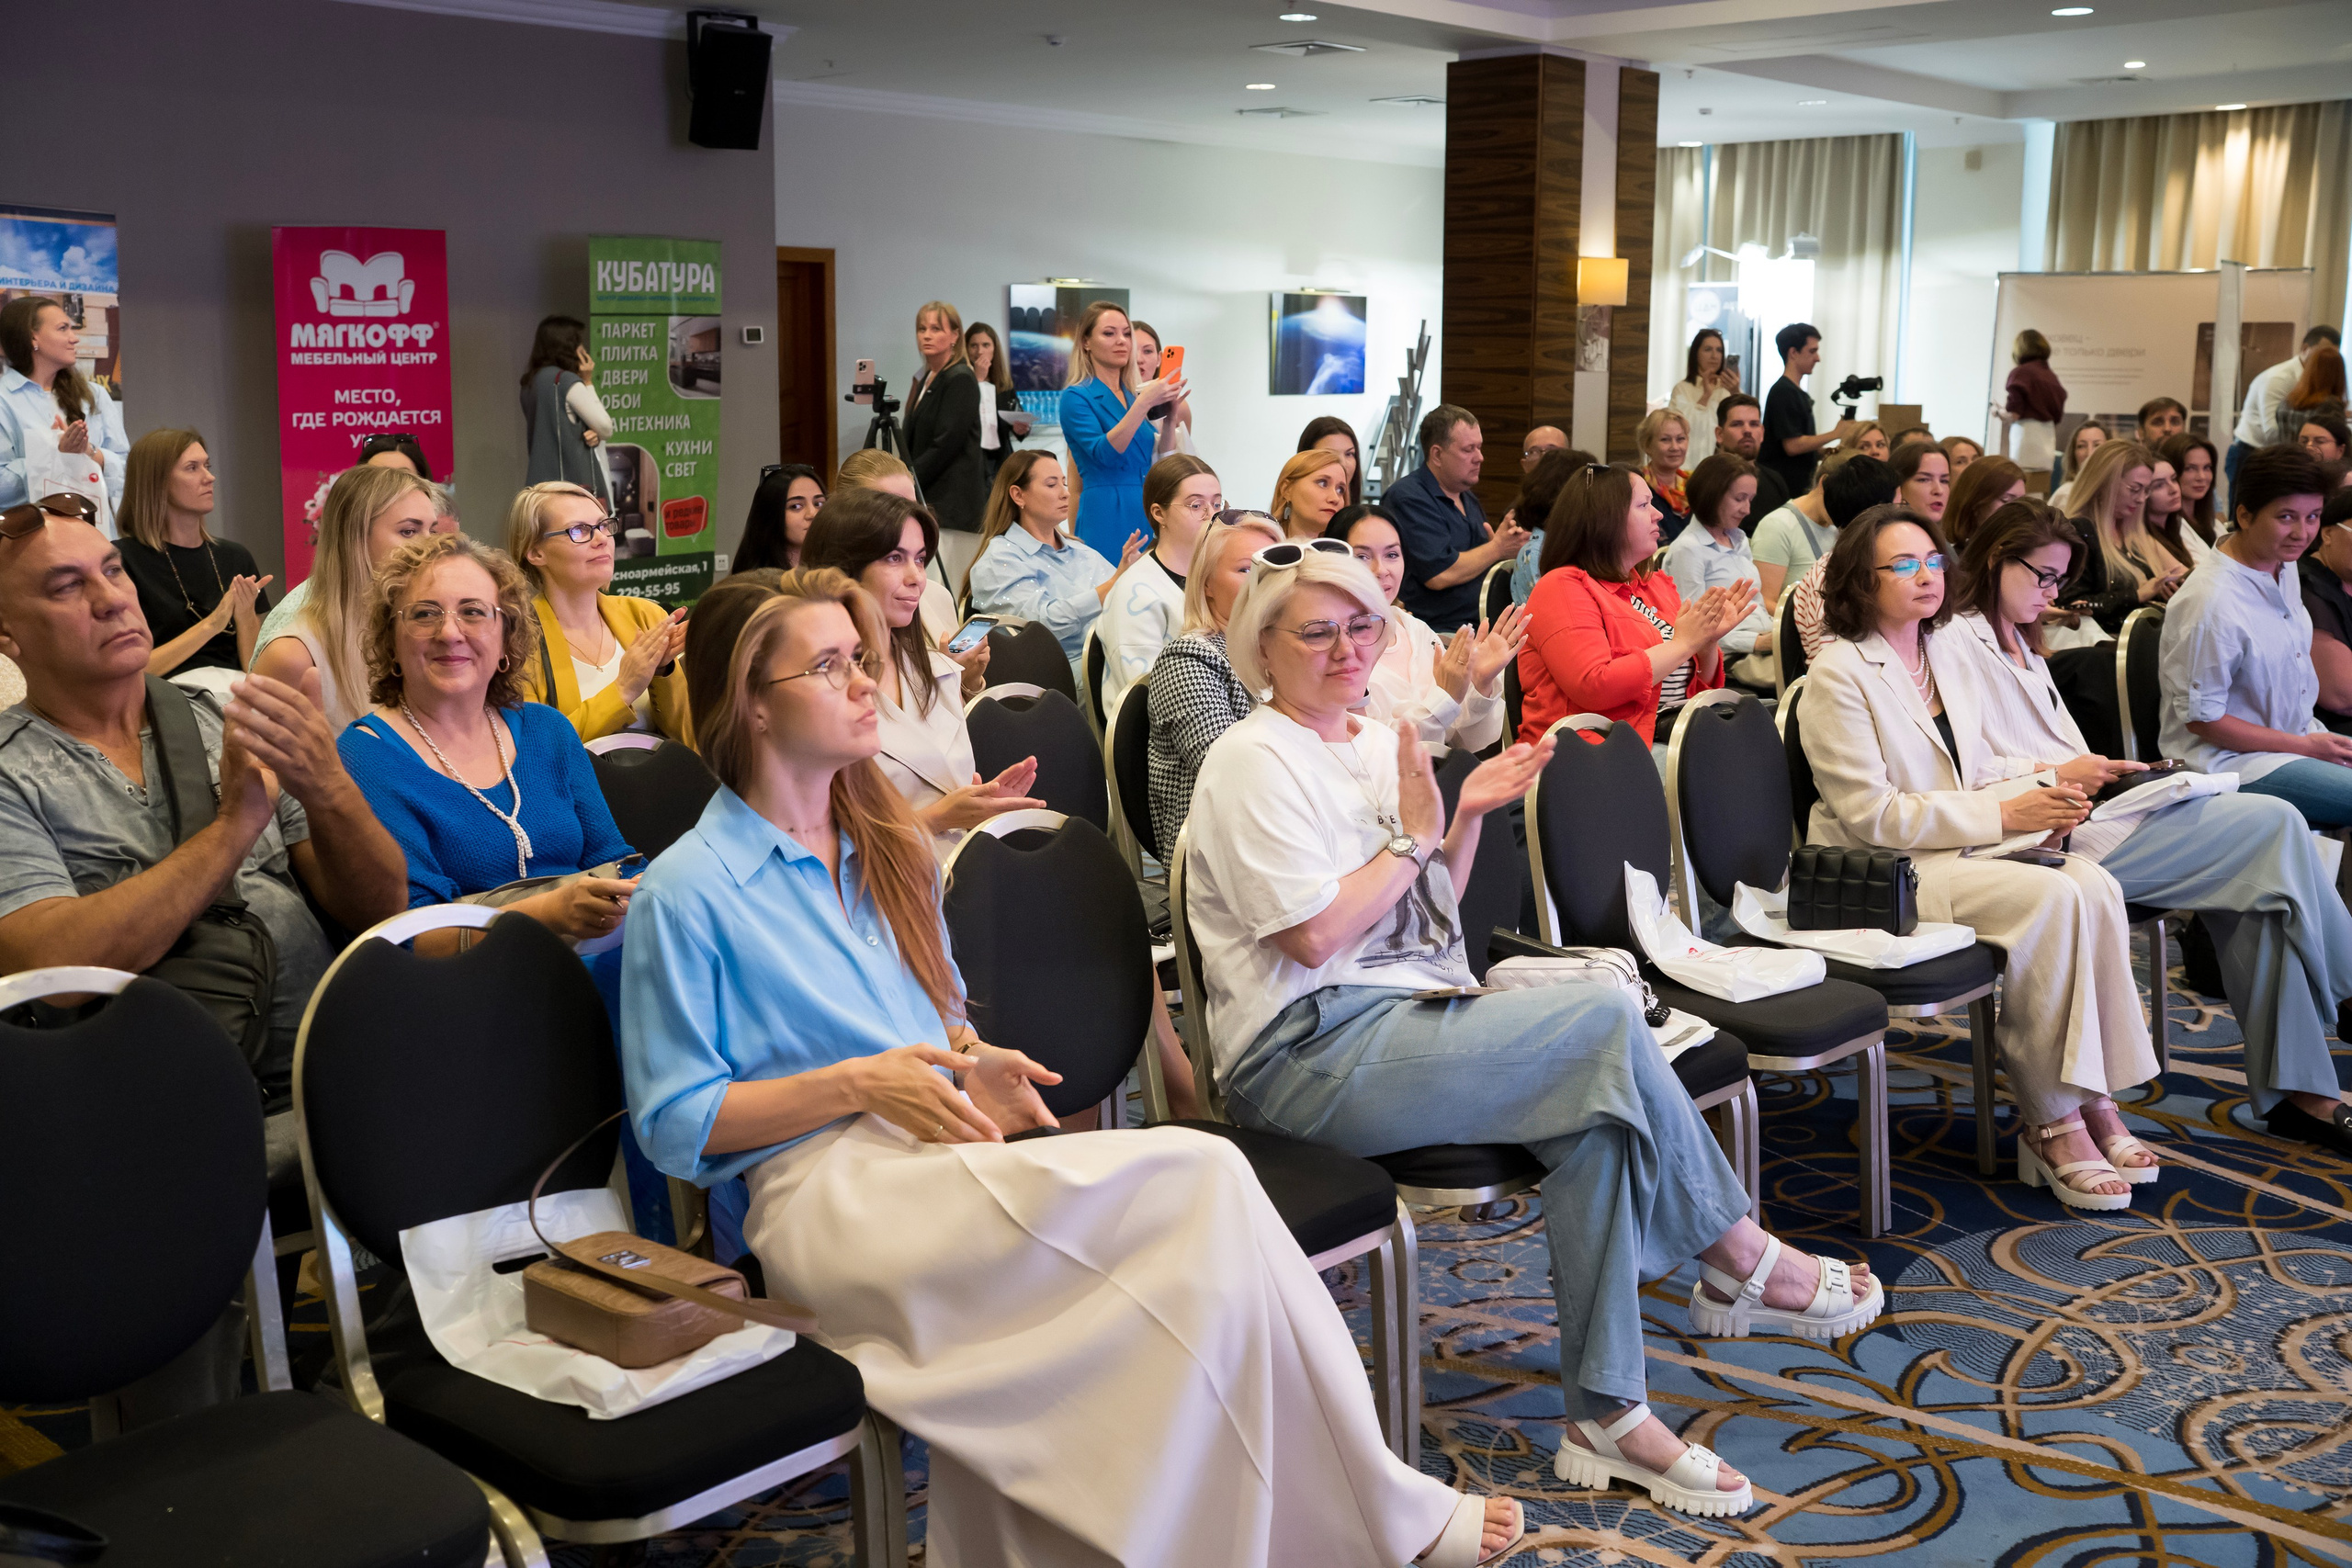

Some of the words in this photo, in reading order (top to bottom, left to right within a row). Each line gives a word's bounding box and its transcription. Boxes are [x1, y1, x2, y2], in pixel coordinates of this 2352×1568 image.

[597, 260, 715, 293] КУБАТУРА
[60, 281, 66, 289] И
[69, 282, 116, 293] ДИЗАЙНА
[602, 322, 656, 338] ПАРКЕТ
[290, 350, 387, 365] МЕБЕЛЬНЫЙ
[390, 352, 437, 367] ЦЕНТР
[601, 345, 658, 361] ПЛИТКА
[601, 369, 648, 389] ДВЕРИ
[334, 389, 401, 406] МЕСТО,
[602, 393, 641, 410] ОБОИ
[292, 412, 326, 430] ГДЕ
[333, 410, 441, 428] РОЖДАЕТСЯ
[611, 414, 691, 432] АНТЕХНИКА
[666, 440, 713, 456] КУХНИ
[665, 461, 696, 478] СВЕТ
[612, 564, 700, 581] сноармейская,
[703, 560, 707, 571] 1
[616, 582, 680, 597] 229-55-95
